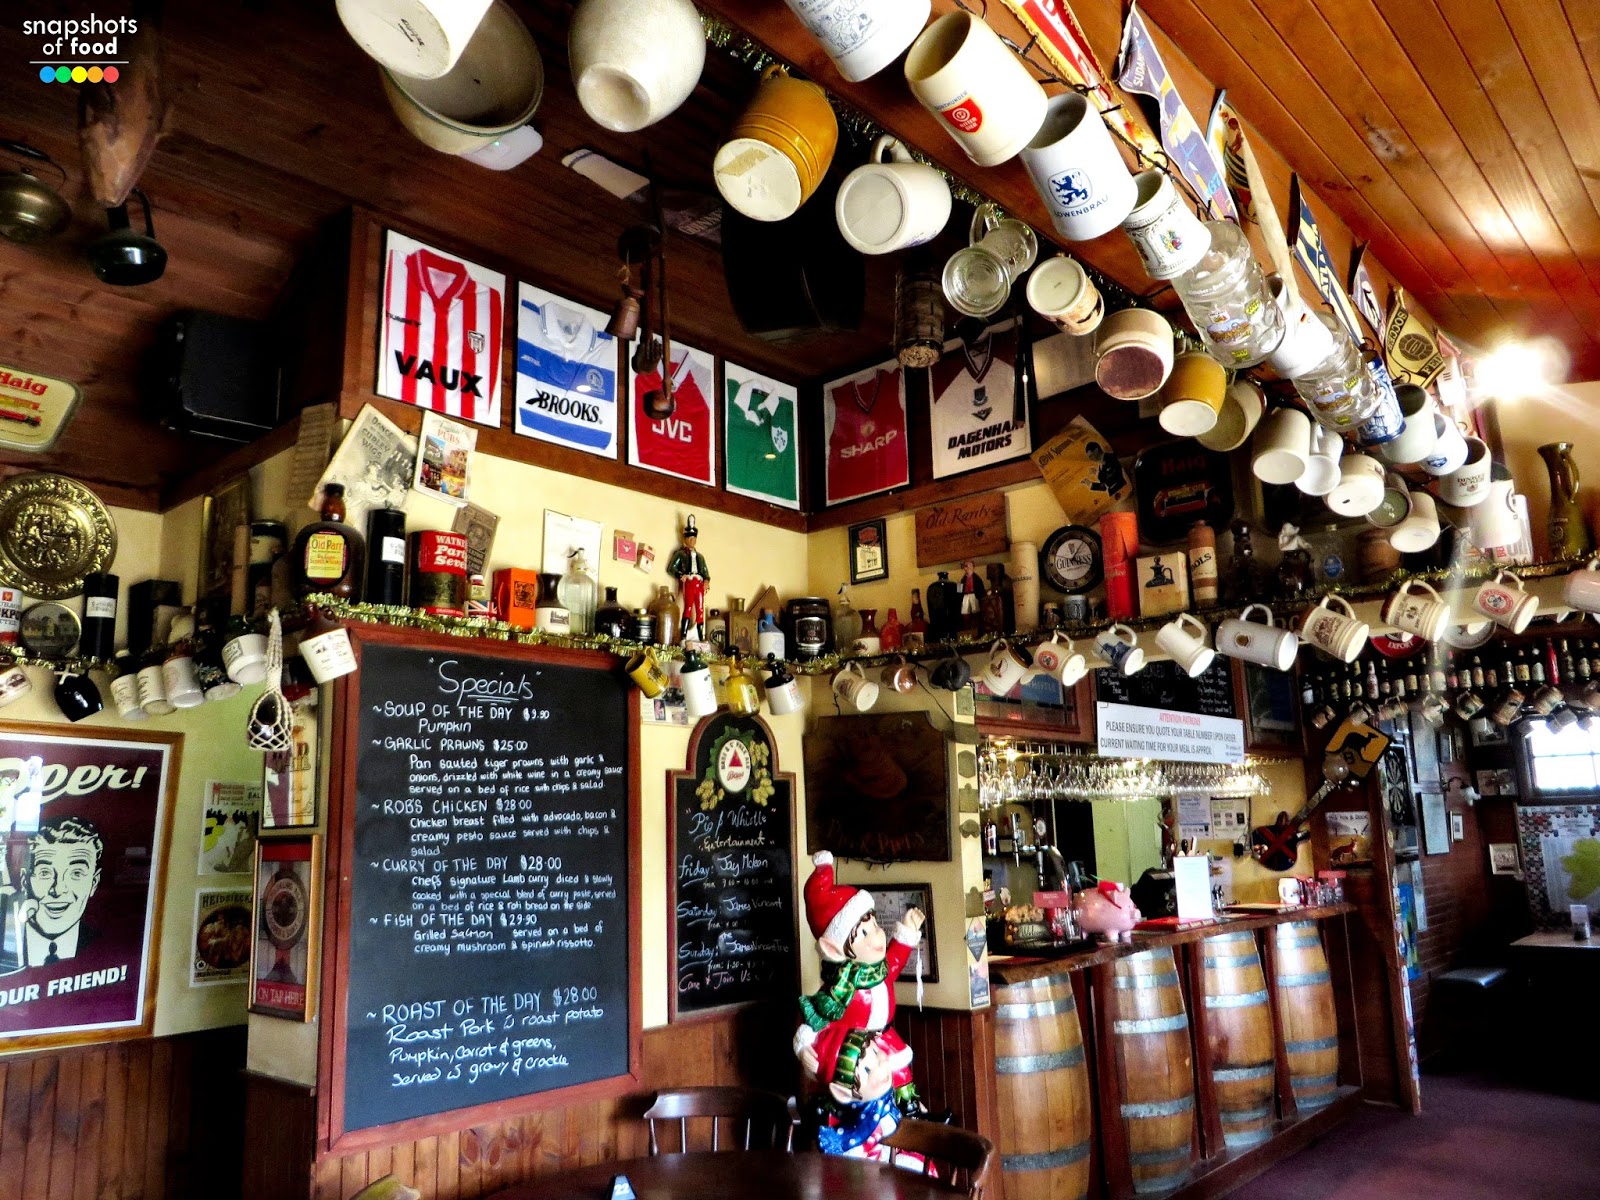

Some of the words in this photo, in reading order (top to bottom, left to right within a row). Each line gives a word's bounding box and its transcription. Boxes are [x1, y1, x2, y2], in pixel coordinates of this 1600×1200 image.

[394, 350, 482, 398] VAUX
[538, 389, 599, 423] BROOKS
[652, 420, 692, 443] JVC
[841, 430, 898, 458] SHARP
[958, 434, 1011, 460] MOTORS
[327, 540, 342, 550] Parr
[1388, 641, 1413, 649] EXPORT
[384, 701, 425, 717] SOUP
[433, 704, 450, 716] OF
[458, 706, 483, 719] THE
[490, 703, 512, 720] DAY
[419, 719, 471, 734] Pumpkin
[1106, 721, 1125, 732] PLEASE
[1126, 723, 1145, 734] ENSURE
[1146, 725, 1155, 734] YOU
[1156, 726, 1170, 736] QUOTE
[1171, 727, 1182, 737] YOUR
[1183, 729, 1195, 739] TABLE
[1196, 730, 1213, 740] NUMBER
[1213, 732, 1224, 741] UPON
[441, 738, 485, 751] PRAWNS
[1101, 738, 1124, 749] CURRENT
[1125, 740, 1145, 750] WAITING
[1146, 741, 1156, 751] TIME
[1157, 742, 1166, 752] FOR
[1167, 743, 1179, 753] YOUR
[1179, 745, 1191, 754] MEAL
[1192, 746, 1196, 754] IS
[410, 754, 431, 769] Pan
[440, 757, 477, 768] sauted
[485, 757, 508, 771] tiger
[513, 758, 543, 770] prawns
[550, 754, 568, 765] with
[443, 771, 477, 782] drizzled
[481, 770, 498, 780] with
[527, 768, 545, 778] wine
[551, 769, 559, 778] in
[605, 766, 623, 775] sauce
[410, 783, 442, 794] served
[448, 786, 459, 794] on
[465, 786, 471, 794] a
[478, 784, 495, 794] bed
[500, 783, 509, 796] of
[515, 783, 530, 793] rice
[411, 817, 447, 828] Chicken
[453, 815, 484, 826] breast
[493, 814, 514, 824] filled
[522, 813, 539, 823] with
[585, 810, 607, 819] bacon
[411, 832, 449, 845] creamy
[489, 831, 516, 839] sauce
[523, 827, 549, 837] served
[554, 826, 571, 836] with
[578, 825, 599, 836] chips
[383, 858, 425, 872] CURRY
[434, 859, 449, 871] OF
[452, 858, 477, 871] THE
[486, 856, 508, 870] DAY
[450, 875, 496, 885] signature
[528, 875, 549, 887] curry
[556, 874, 578, 884] diced
[450, 890, 467, 900] with
[481, 890, 509, 901] special
[517, 889, 534, 899] blend
[538, 889, 546, 900] of
[550, 891, 568, 901] curry
[441, 901, 459, 910] bed
[465, 901, 474, 911] of
[479, 901, 494, 910] rice
[525, 900, 548, 910] bread
[550, 902, 561, 910] on
[421, 915, 436, 926] OF
[440, 914, 464, 925] THE
[471, 914, 493, 926] DAY
[414, 930, 446, 940] Grilled
[513, 927, 542, 937] served
[574, 923, 588, 934] bed
[595, 920, 603, 933] of
[414, 944, 450, 955] creamy
[457, 942, 506, 950] mushroom
[47, 965, 127, 997] FRIEND!
[383, 1000, 446, 1024] ROAST
[453, 999, 474, 1016] OF
[481, 996, 507, 1014] THE
[514, 992, 541, 1011] DAY
[386, 1024, 453, 1043] Roast
[460, 1018, 495, 1037] Pork
[522, 1012, 560, 1024] roast
[565, 1006, 603, 1024] potato
[470, 1061, 509, 1083] gravy
